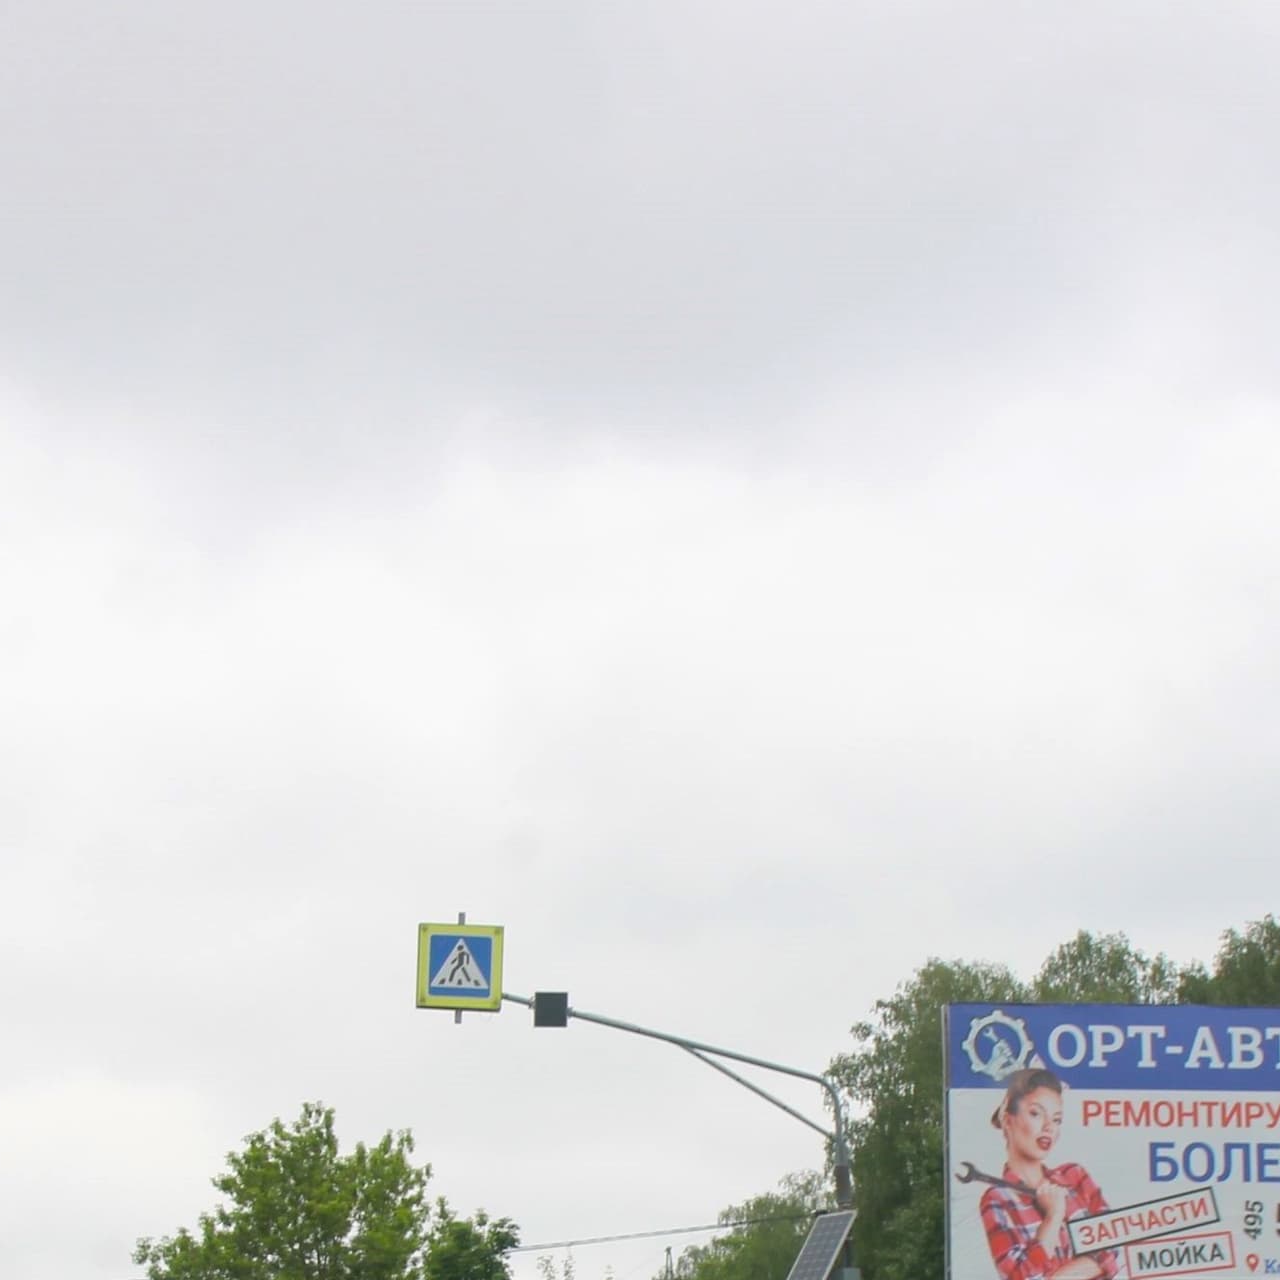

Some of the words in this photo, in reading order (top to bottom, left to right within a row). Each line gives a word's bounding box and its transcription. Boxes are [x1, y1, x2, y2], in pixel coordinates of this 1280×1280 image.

[1078, 1197, 1209, 1246] ЗАПЧАСТИ
[1243, 1200, 1264, 1240] 495
[1138, 1241, 1225, 1270] МОЙКА
